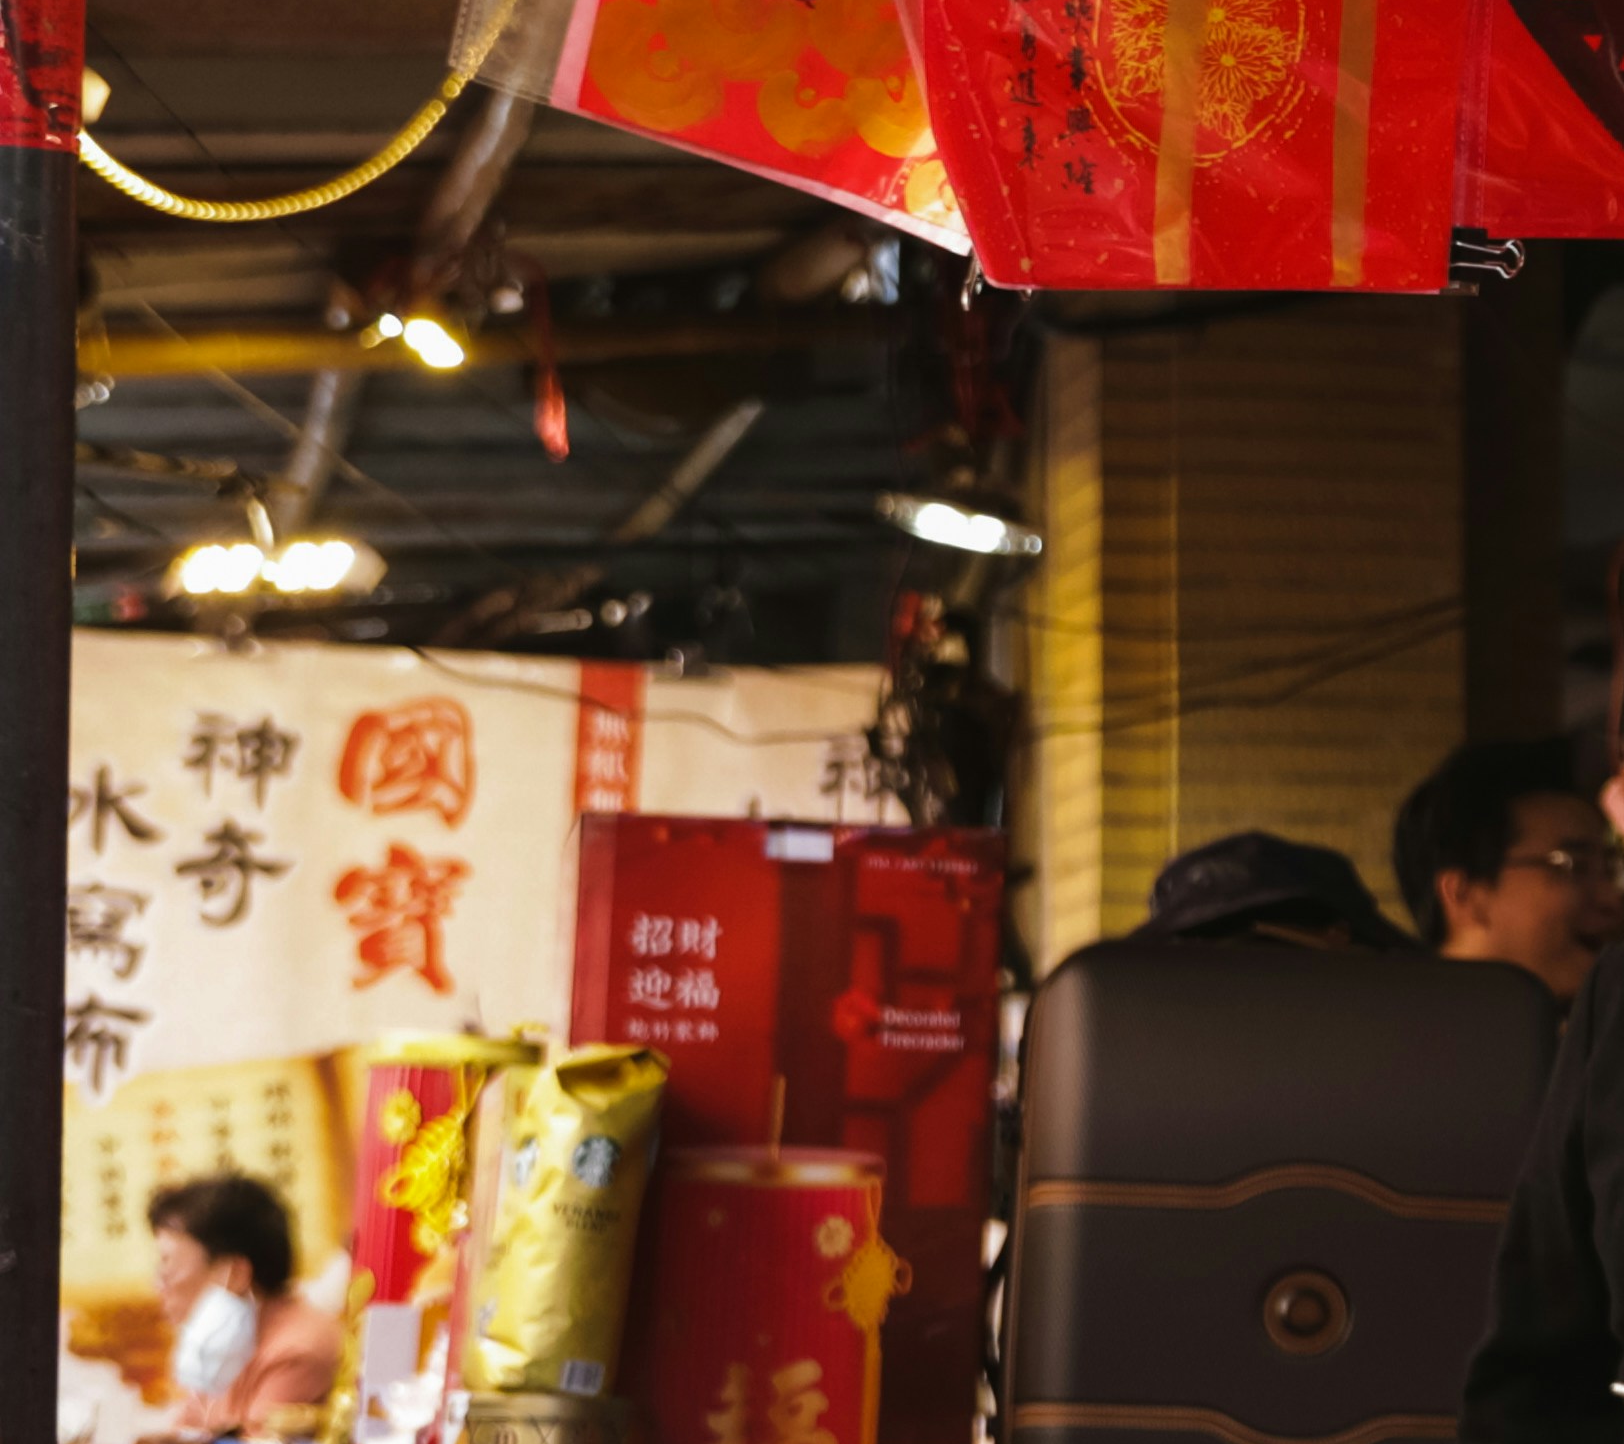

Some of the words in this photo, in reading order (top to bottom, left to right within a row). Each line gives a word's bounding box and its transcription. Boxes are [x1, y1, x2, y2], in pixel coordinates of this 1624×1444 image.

[174, 713, 299, 925] 神奇
[336, 695, 475, 996] 國寶
[627, 967, 721, 1012] 迎福
[631, 913, 723, 961] 招財
